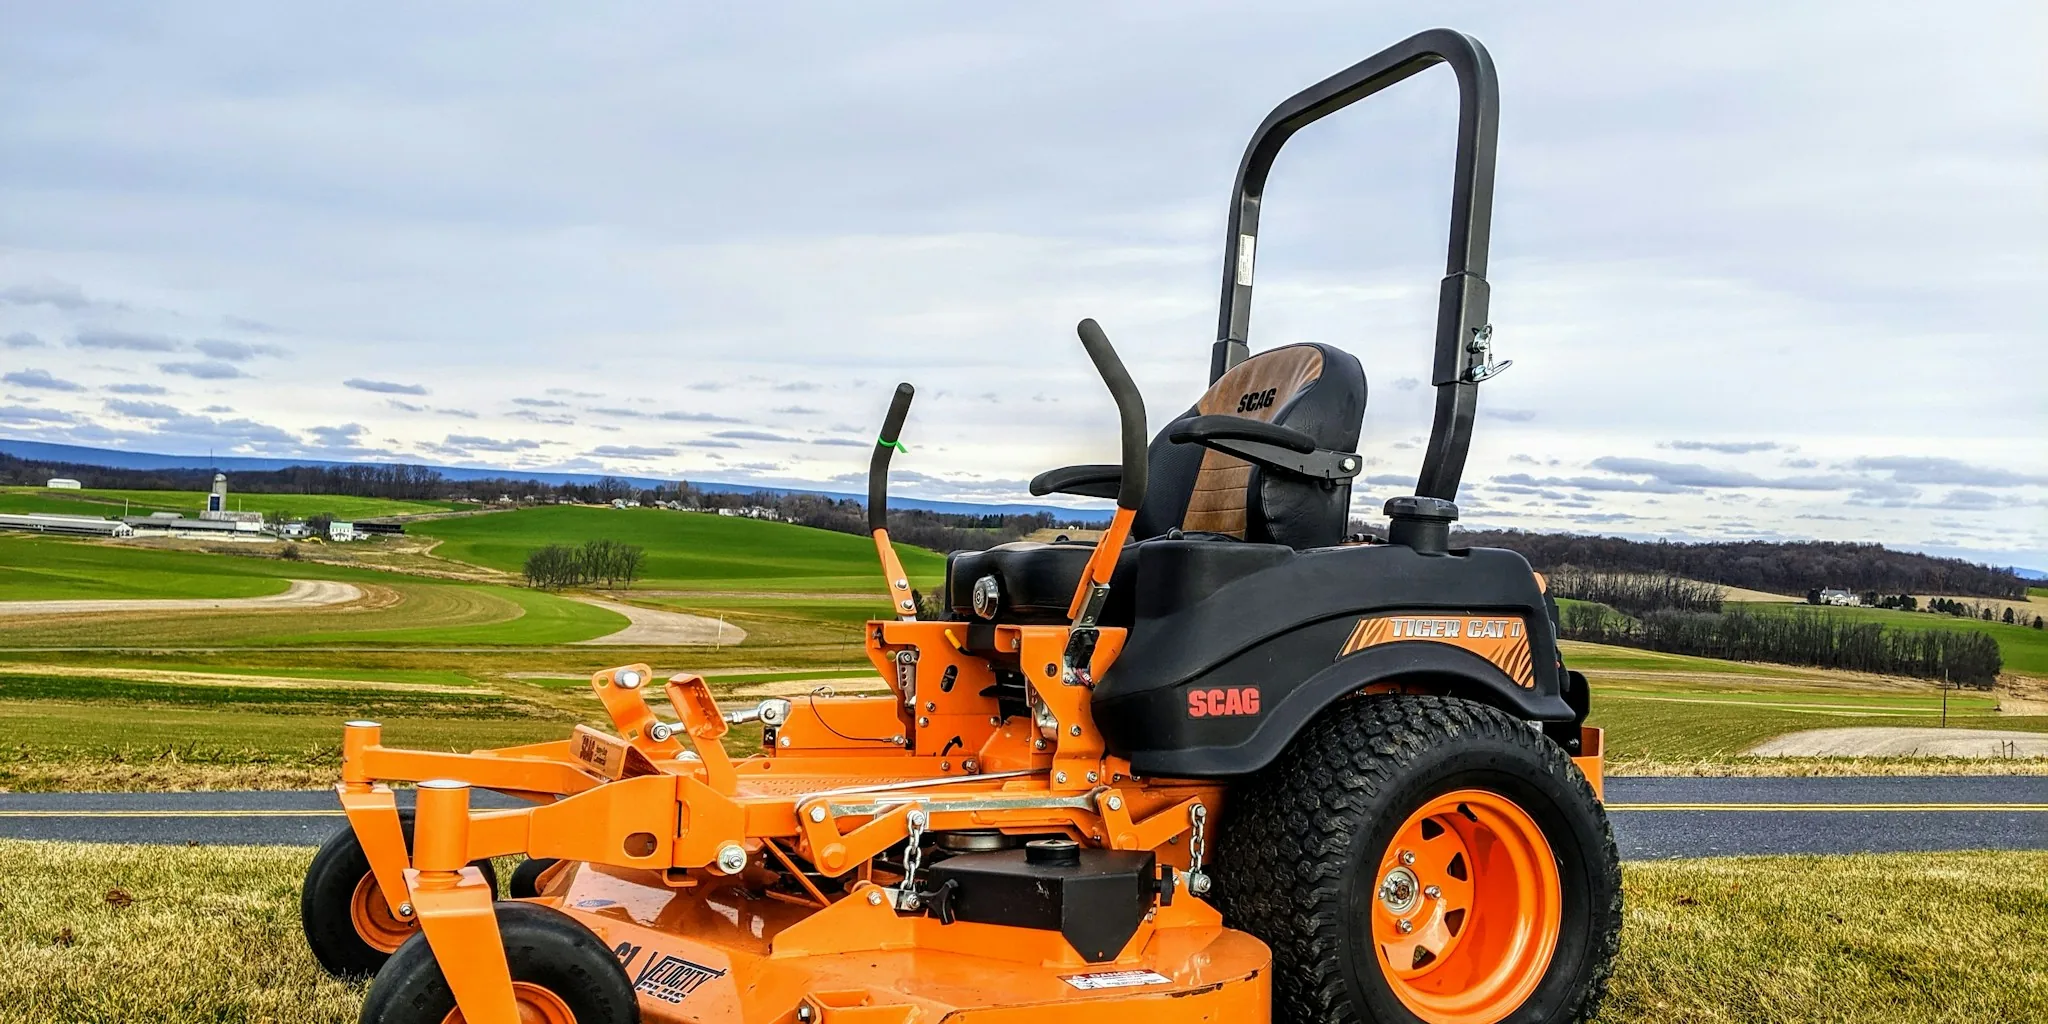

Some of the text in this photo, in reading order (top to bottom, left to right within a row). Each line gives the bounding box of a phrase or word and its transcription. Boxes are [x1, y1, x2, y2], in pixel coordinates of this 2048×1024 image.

[1237, 387, 1277, 413] SCAG
[1390, 619, 1461, 638] TIGER
[1466, 620, 1508, 639] CAT
[1188, 688, 1260, 717] SCAG
[633, 951, 728, 994] VELOCITY
[635, 981, 686, 1004] PLUS
